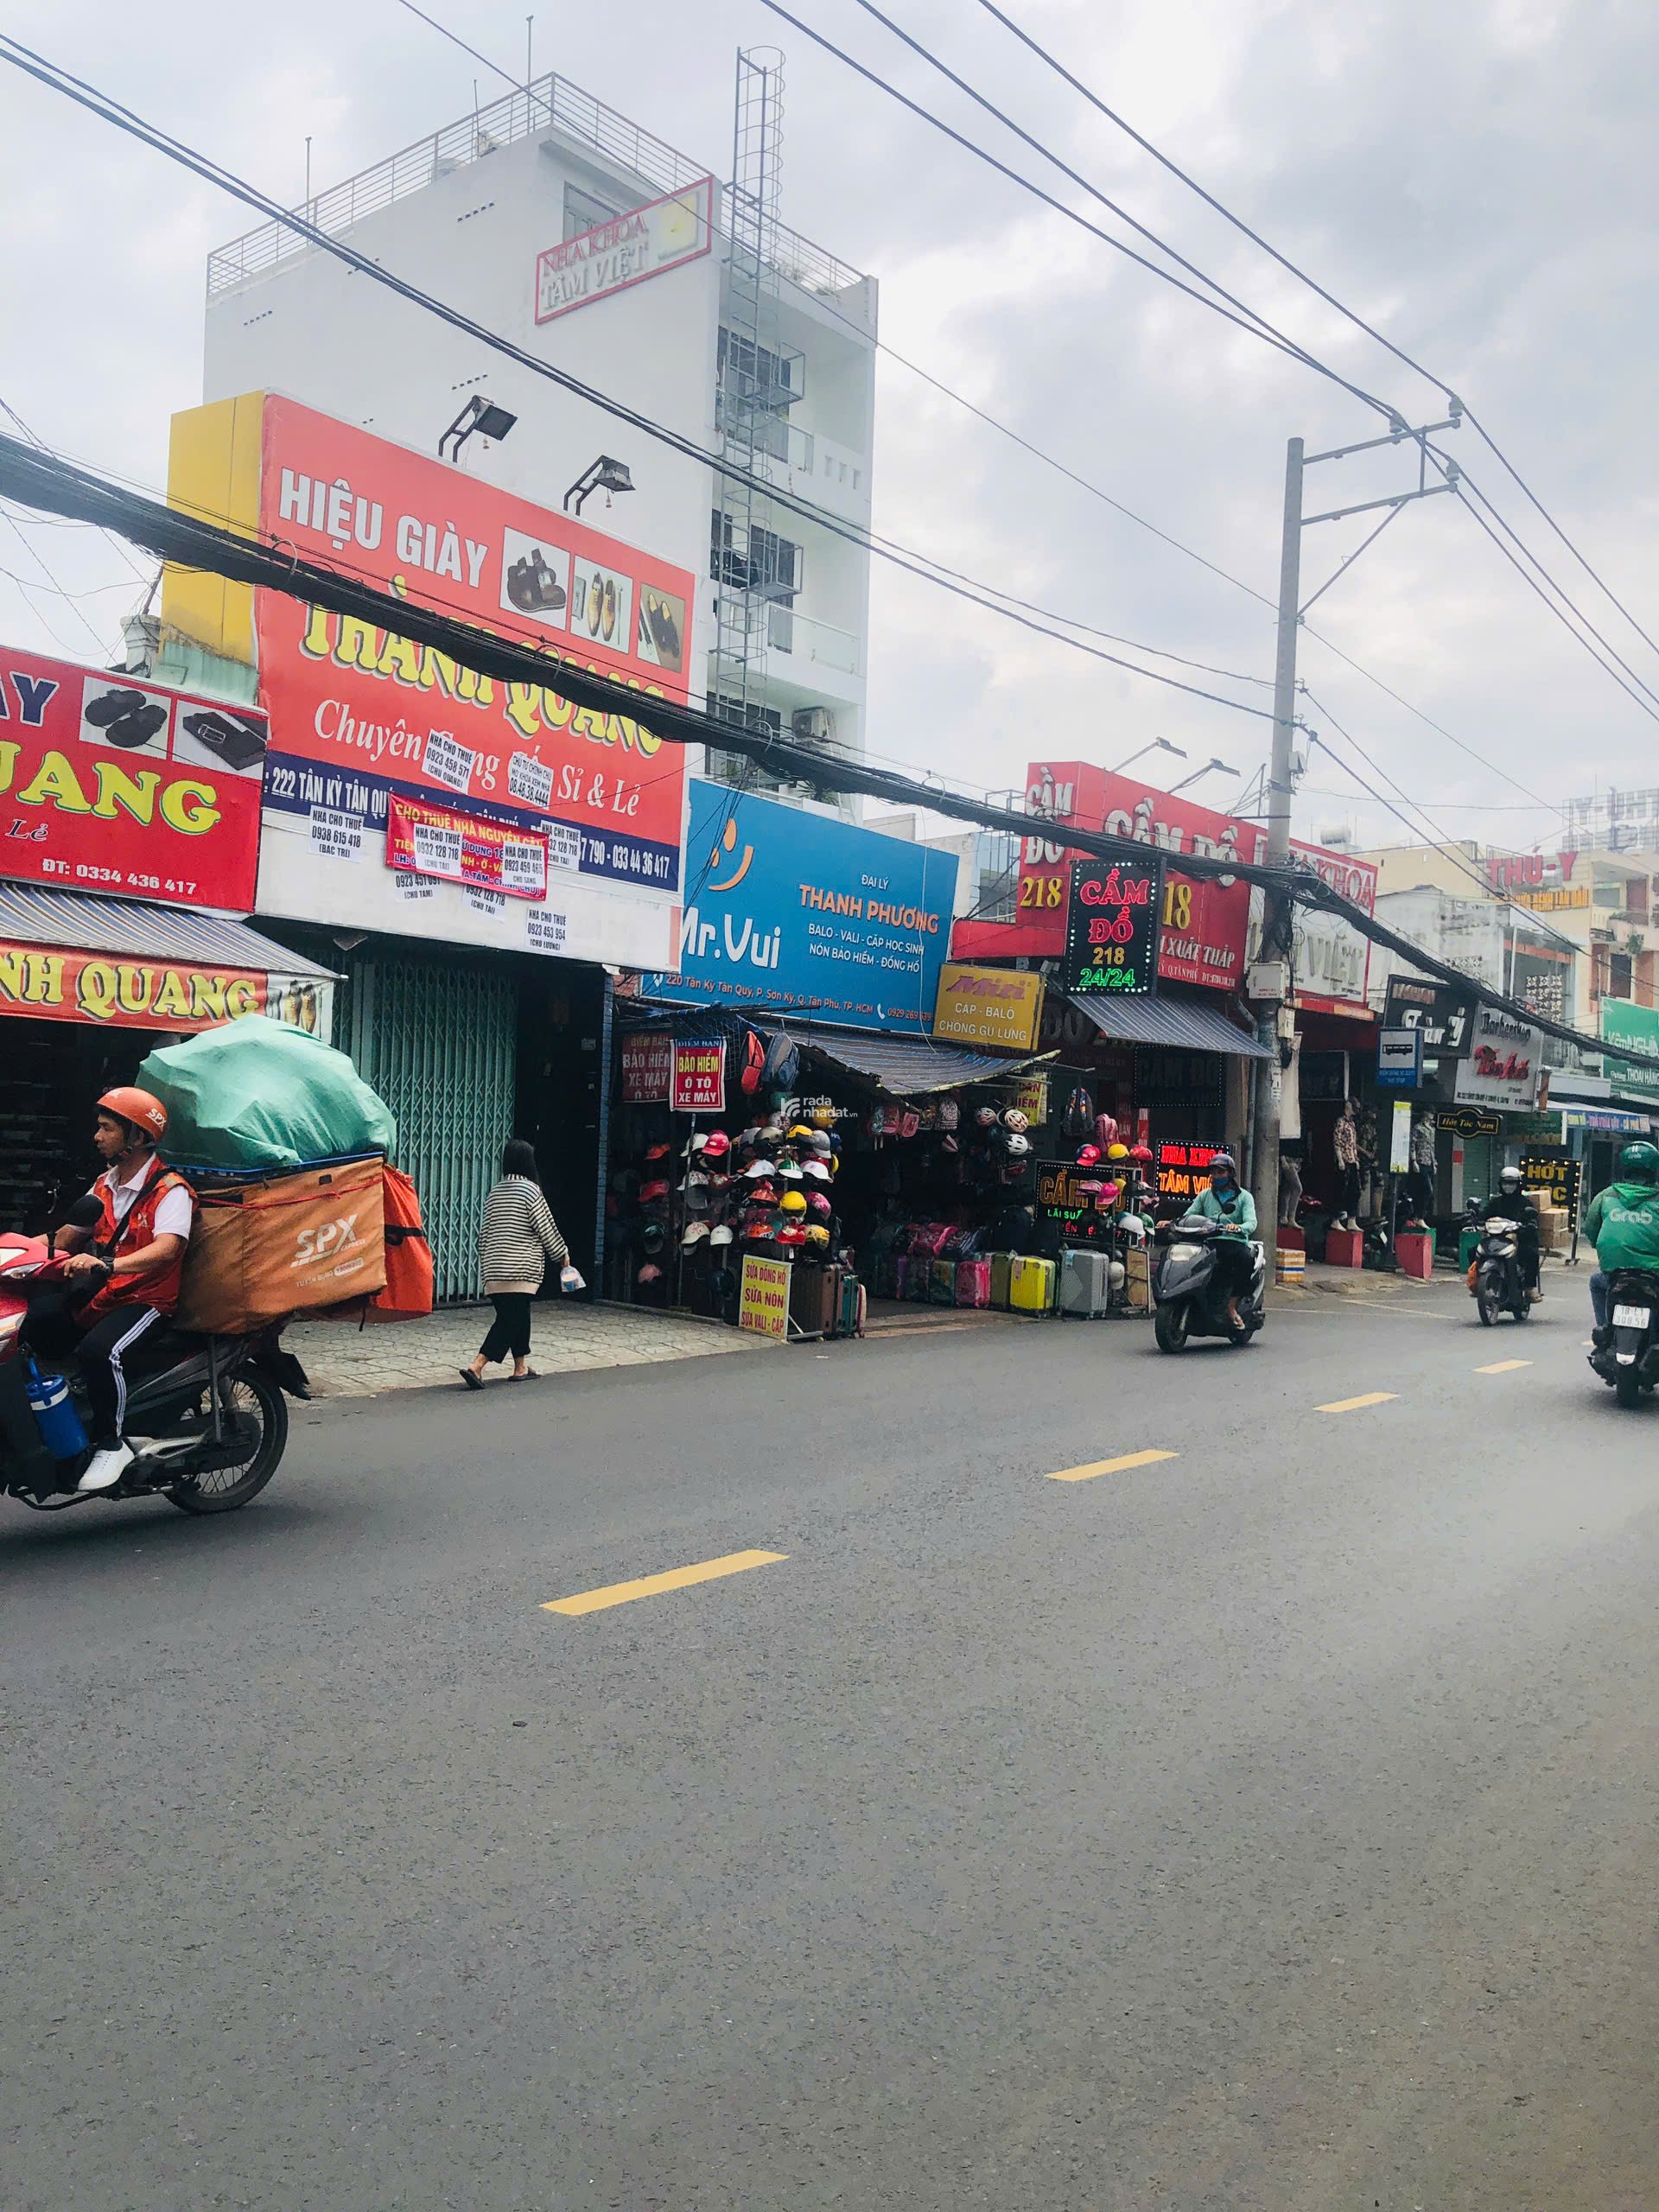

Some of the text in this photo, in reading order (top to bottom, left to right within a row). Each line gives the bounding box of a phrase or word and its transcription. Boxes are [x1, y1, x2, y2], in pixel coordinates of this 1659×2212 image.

[278, 467, 488, 588] HIỆU GIÀY
[314, 699, 423, 762] Chuyên
[557, 765, 584, 802] Sỉ
[587, 772, 606, 809] &
[443, 741, 456, 755] CHO
[271, 767, 296, 798] 222
[299, 768, 323, 804] TÂN
[326, 774, 343, 807] KỲ
[346, 779, 369, 814] TÂN
[371, 787, 394, 820] QU
[589, 839, 606, 865] 790
[613, 845, 628, 871] 033
[630, 849, 641, 874] 44
[642, 852, 653, 876] 36
[654, 855, 671, 879] 417
[328, 815, 344, 829] CHO
[395, 804, 420, 821] CHO
[422, 810, 452, 830] THUÊ
[454, 817, 476, 837] NHÀ
[312, 826, 361, 848] 0938 615 418
[429, 830, 443, 843] CHO
[435, 845, 447, 858] 128
[42, 858, 197, 895] ĐT: 0334 436 417
[861, 874, 877, 890] ĐẠI
[1020, 876, 1063, 908] 218
[540, 912, 552, 924] CHO
[799, 884, 939, 935] THANH PHƯƠNG
[808, 923, 925, 956] BALO VALI CẶP HỌC SINH
[810, 942, 830, 957] NÓN
[831, 945, 851, 961] BẢO
[1092, 947, 1125, 964] 218
[666, 974, 683, 986] 220
[1079, 968, 1135, 987] 24/24
[76, 962, 258, 1021] QUANG
[678, 1051, 696, 1072] BẢO
[684, 1076, 712, 1089] Ô TÔ
[678, 1090, 716, 1103] XE MÁY
[146, 1108, 168, 1131] SPX
[1158, 1168, 1190, 1194] TÂM
[1609, 1208, 1653, 1224] Grab
[293, 1213, 359, 1260] SPX
[765, 1290, 785, 1309] NÓN
